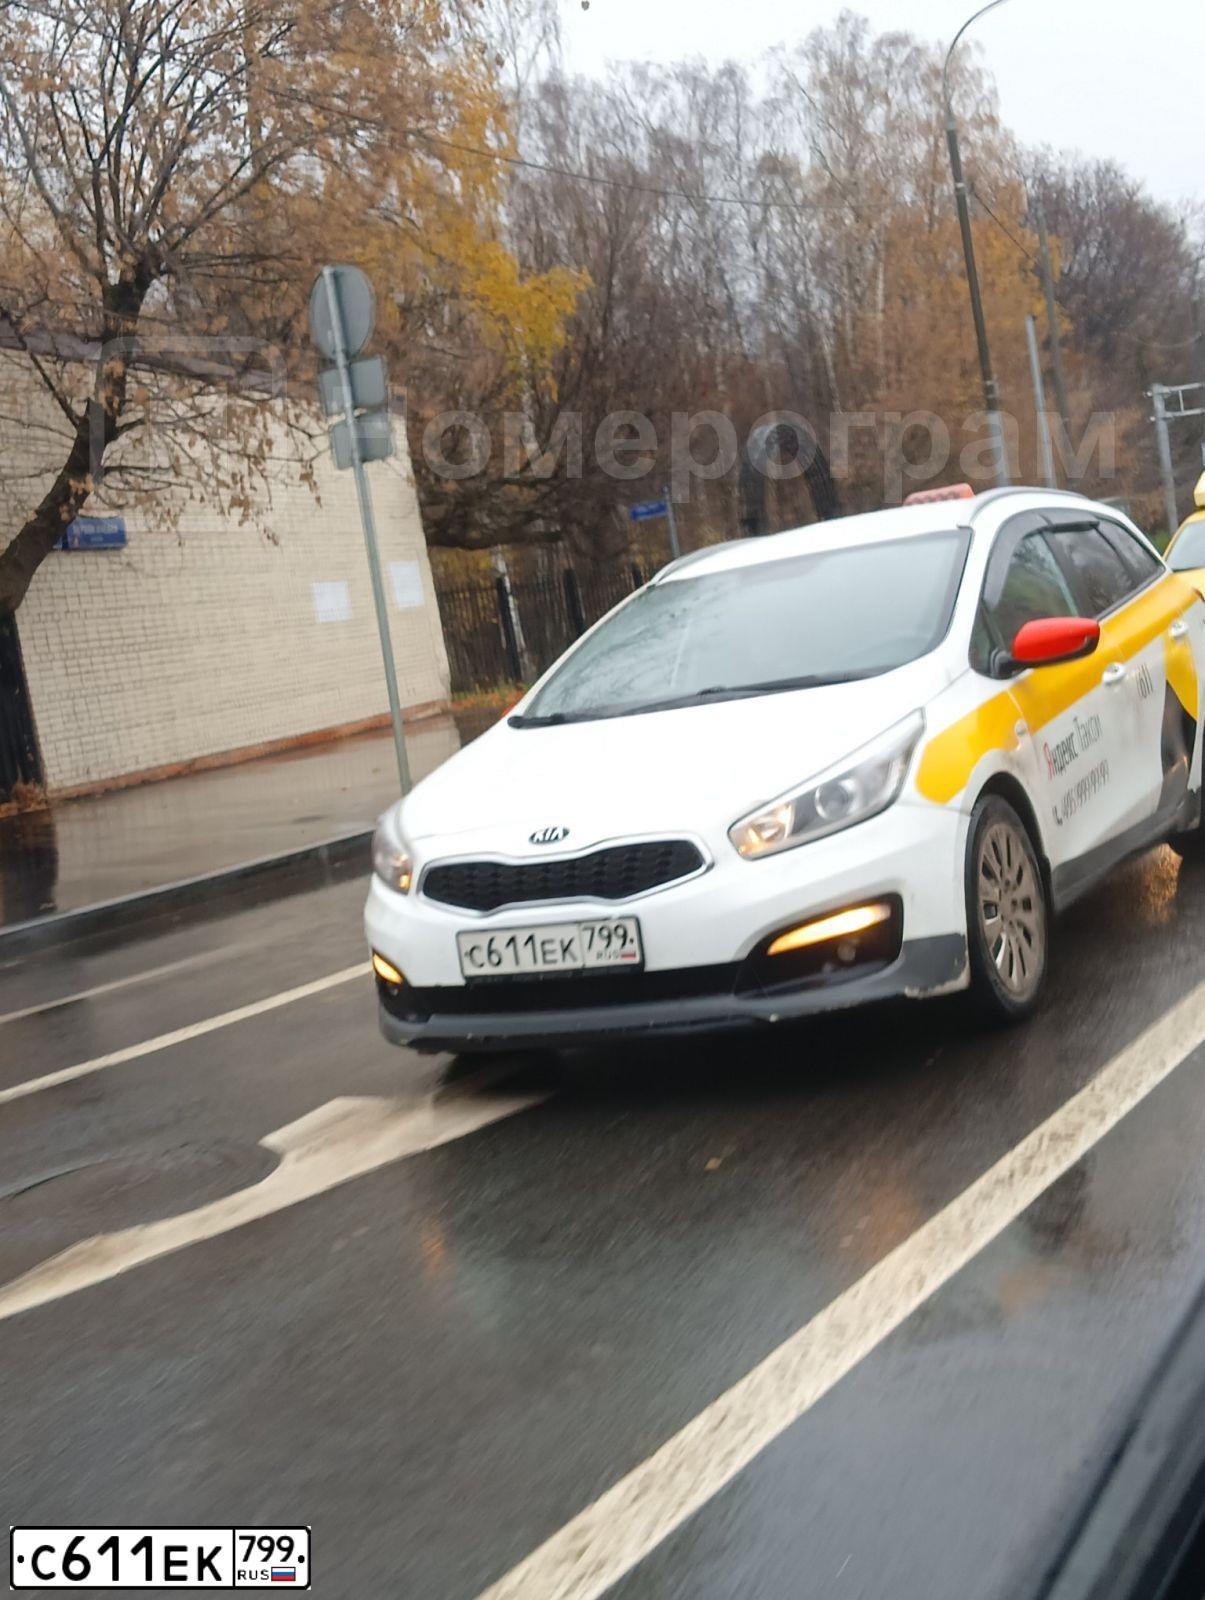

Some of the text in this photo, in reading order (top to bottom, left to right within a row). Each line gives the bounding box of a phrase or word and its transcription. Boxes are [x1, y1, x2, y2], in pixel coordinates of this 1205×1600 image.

[1043, 716, 1102, 780] Яндекс Такси
[467, 924, 627, 968] С611ЕК 799
